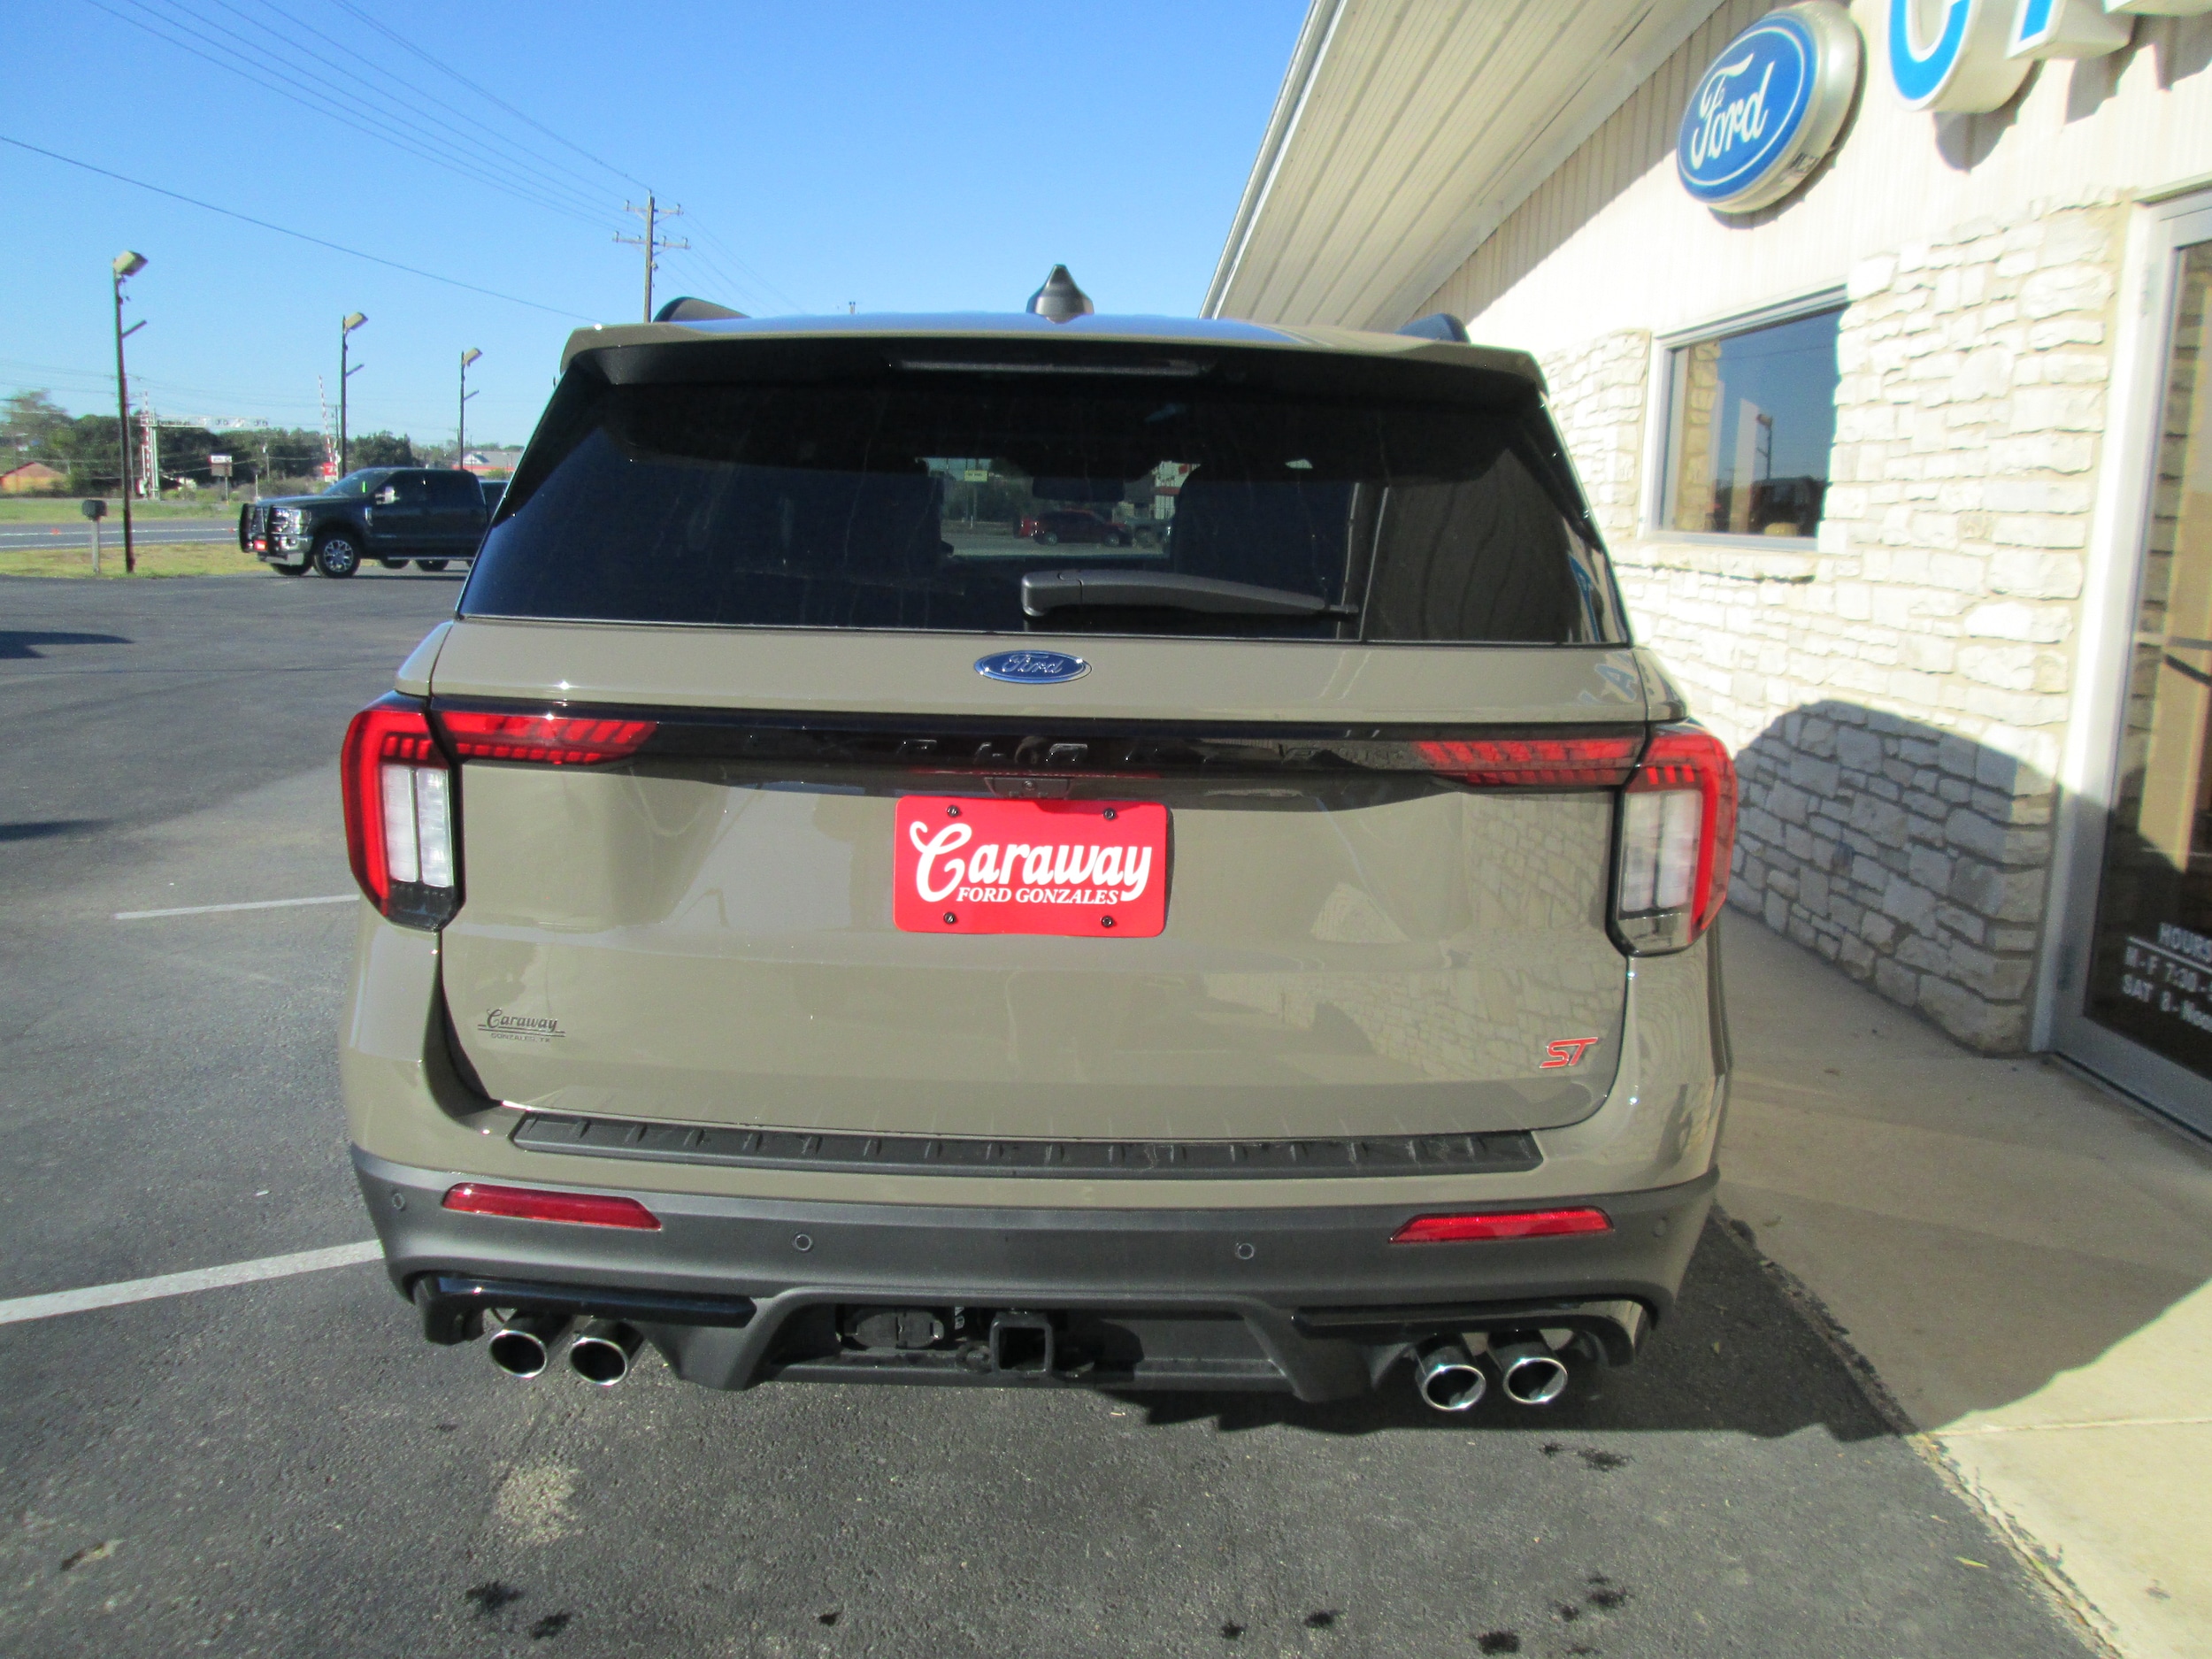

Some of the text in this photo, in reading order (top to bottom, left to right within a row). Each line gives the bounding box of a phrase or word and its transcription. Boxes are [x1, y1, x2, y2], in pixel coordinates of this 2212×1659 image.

[1691, 53, 1775, 171] Ford
[1002, 654, 1064, 673] Ford
[910, 820, 1153, 902] Caraway
[956, 887, 1119, 905] FORD GONZALES
[487, 1008, 558, 1033] Caraway
[1540, 1036, 1599, 1068] ST
